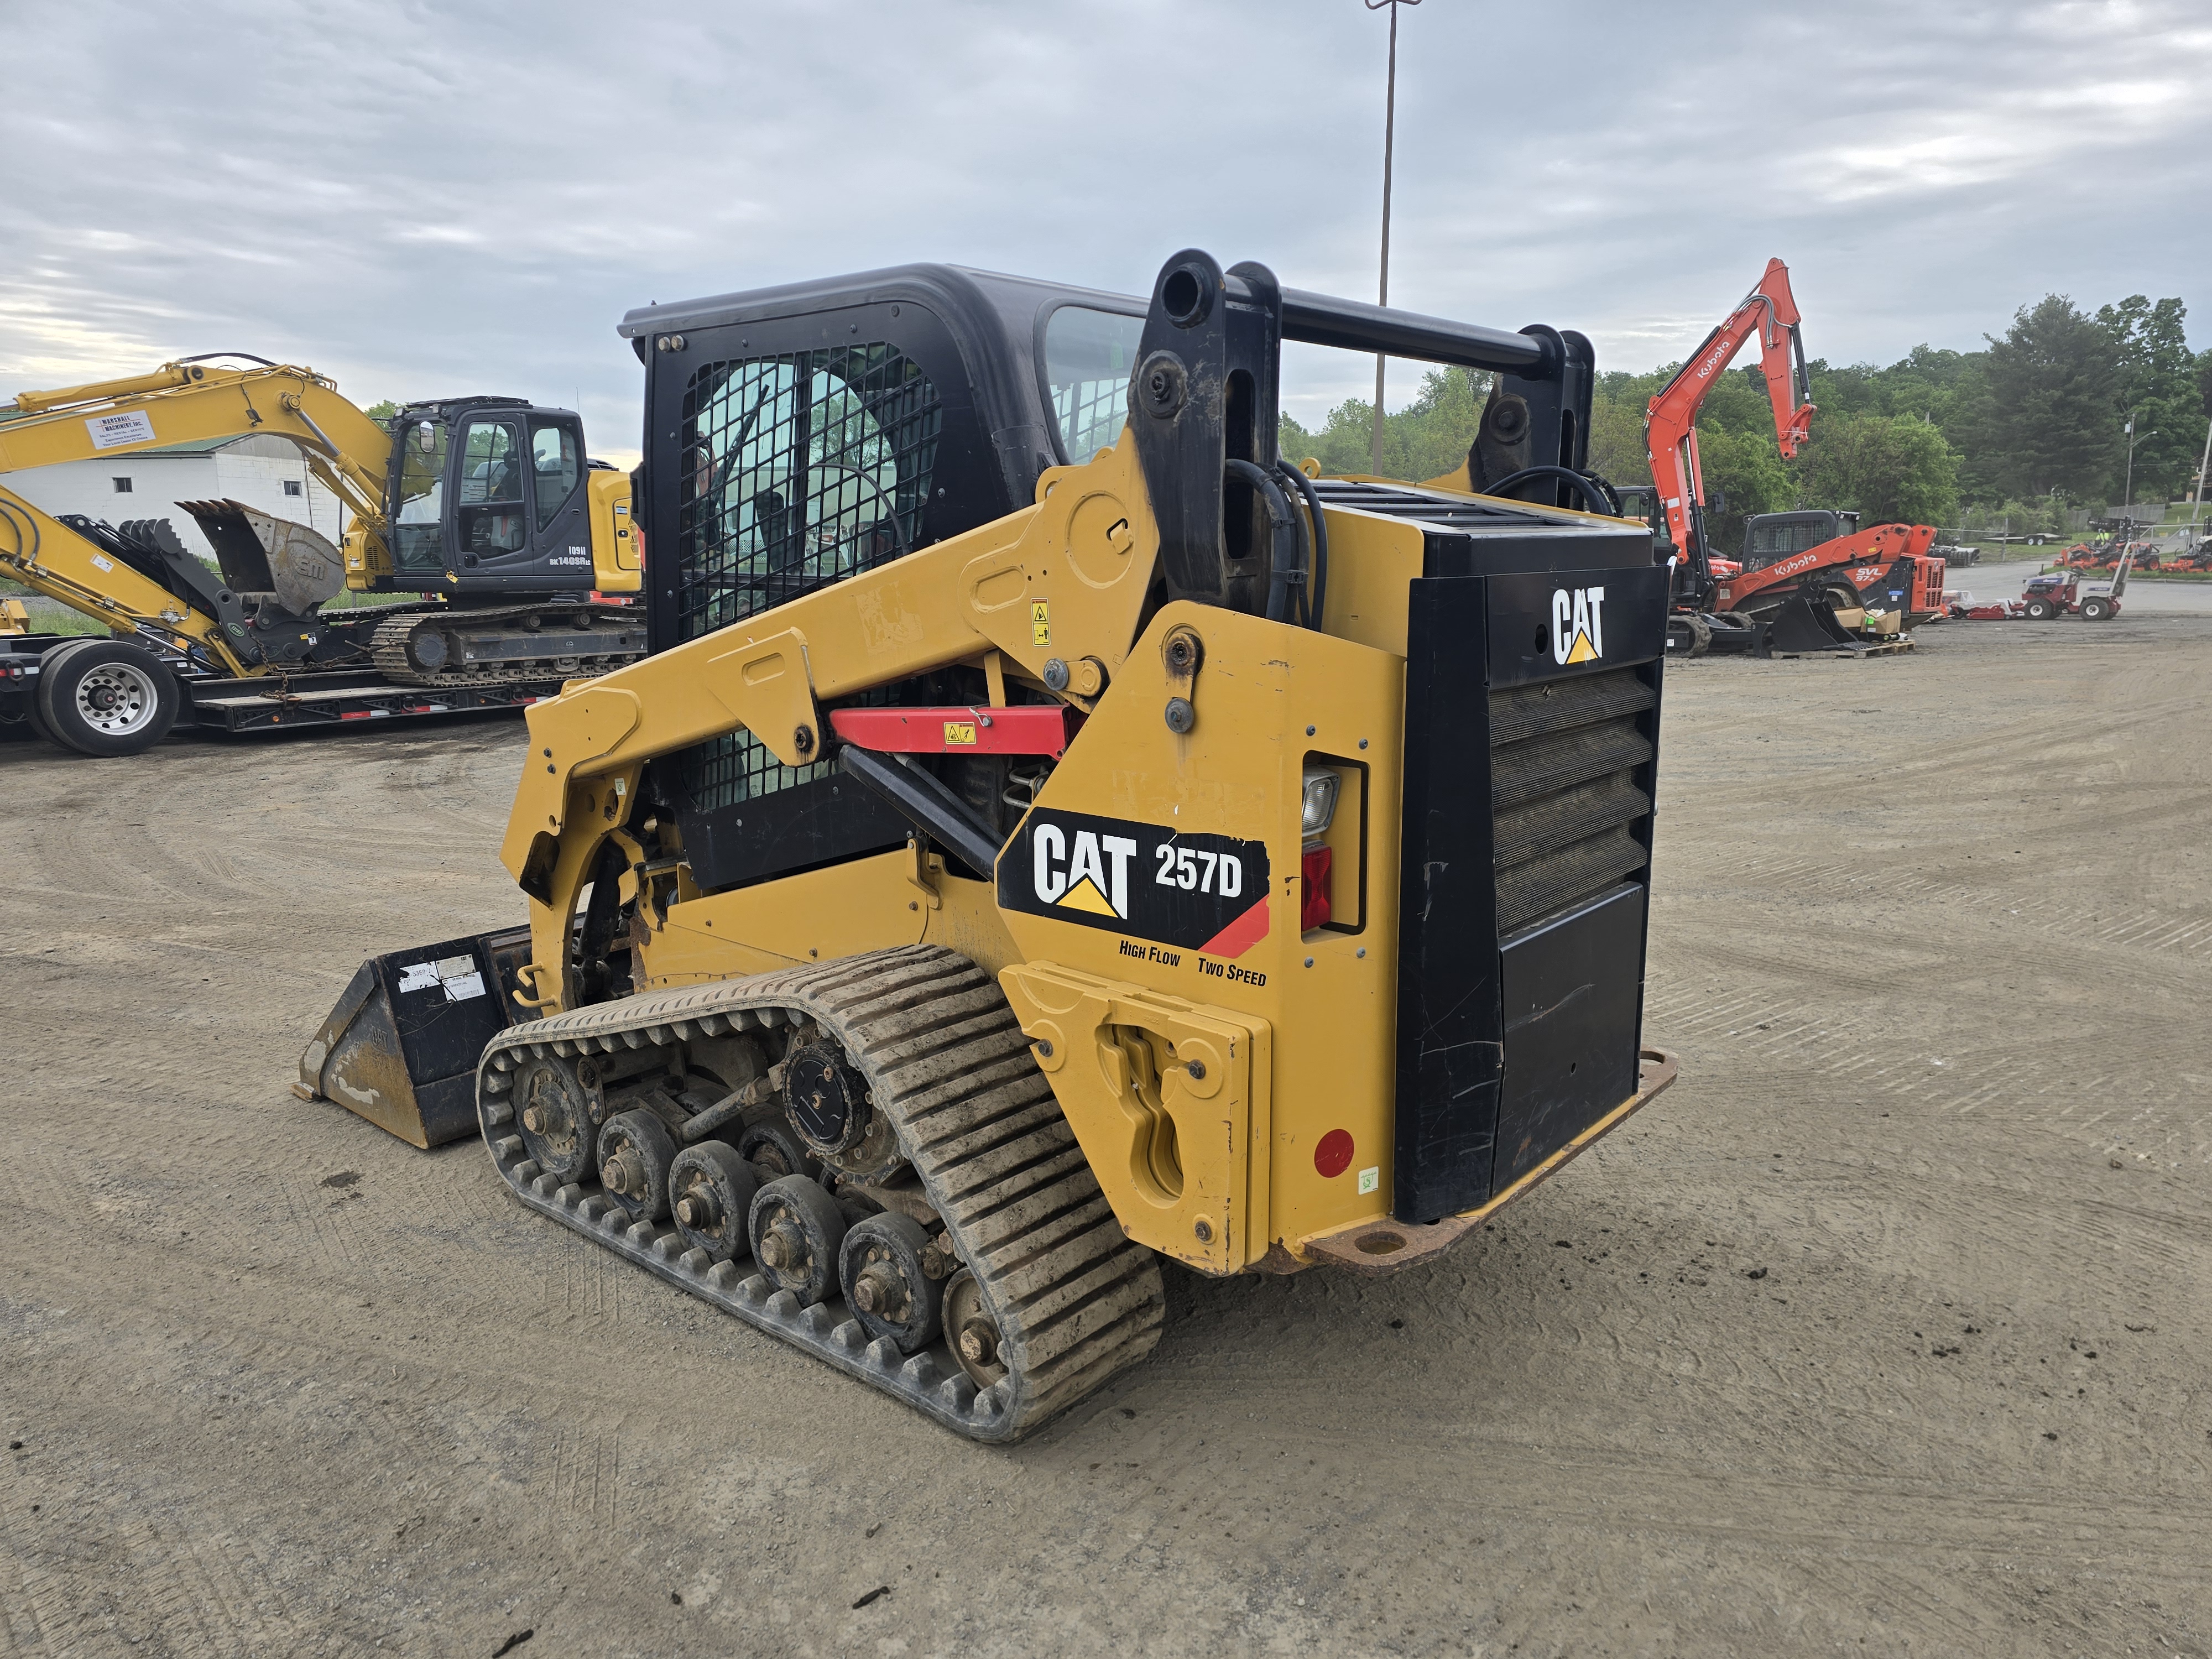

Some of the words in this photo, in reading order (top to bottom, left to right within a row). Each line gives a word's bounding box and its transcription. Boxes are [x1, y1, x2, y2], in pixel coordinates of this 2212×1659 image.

[1697, 341, 1730, 378] Kubota
[102, 415, 131, 425] MARSHALL
[1774, 555, 1817, 575] Kubota
[1855, 567, 1883, 576] SVL
[1552, 586, 1604, 665] CAT
[1034, 823, 1136, 920] CAT
[1155, 844, 1242, 898] 257D
[371, 1025, 388, 1050] CAT
